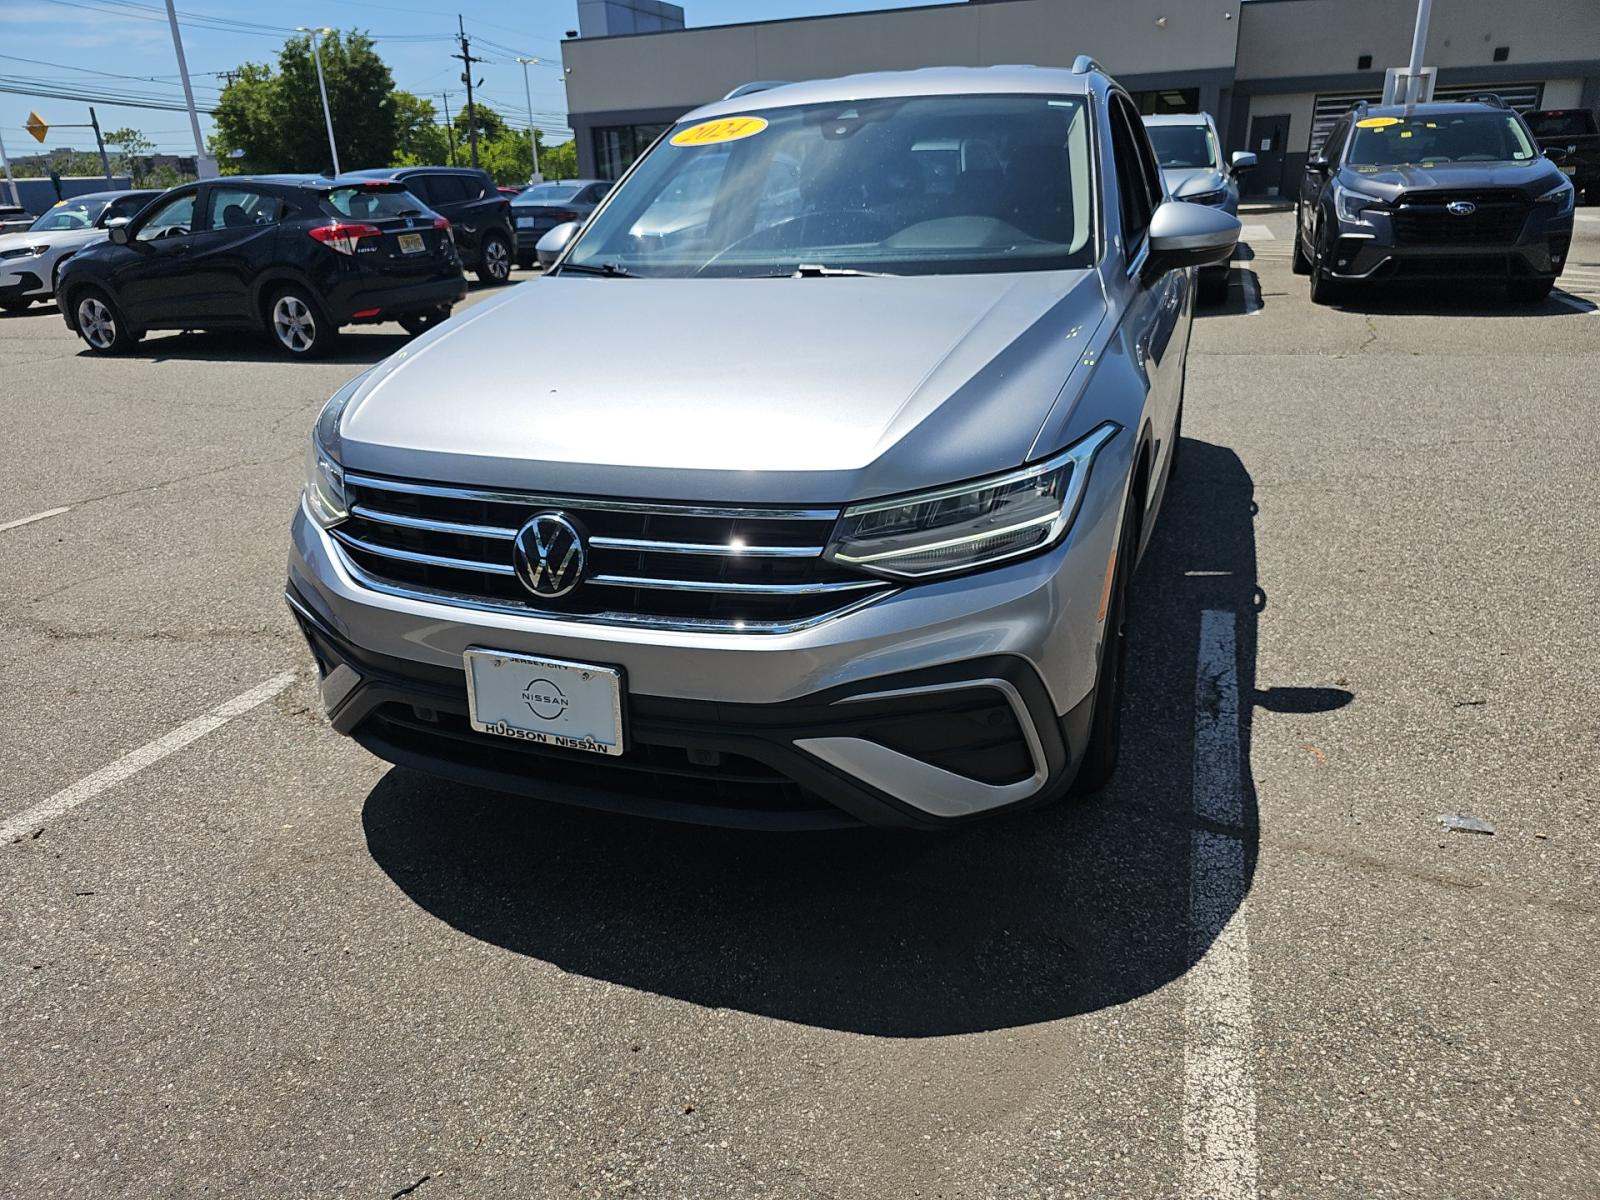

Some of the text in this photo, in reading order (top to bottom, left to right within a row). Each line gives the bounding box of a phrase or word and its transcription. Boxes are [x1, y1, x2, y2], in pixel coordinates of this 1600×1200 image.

[521, 692, 569, 706] NISSAN
[485, 724, 608, 753] HUDSON NISSAN
